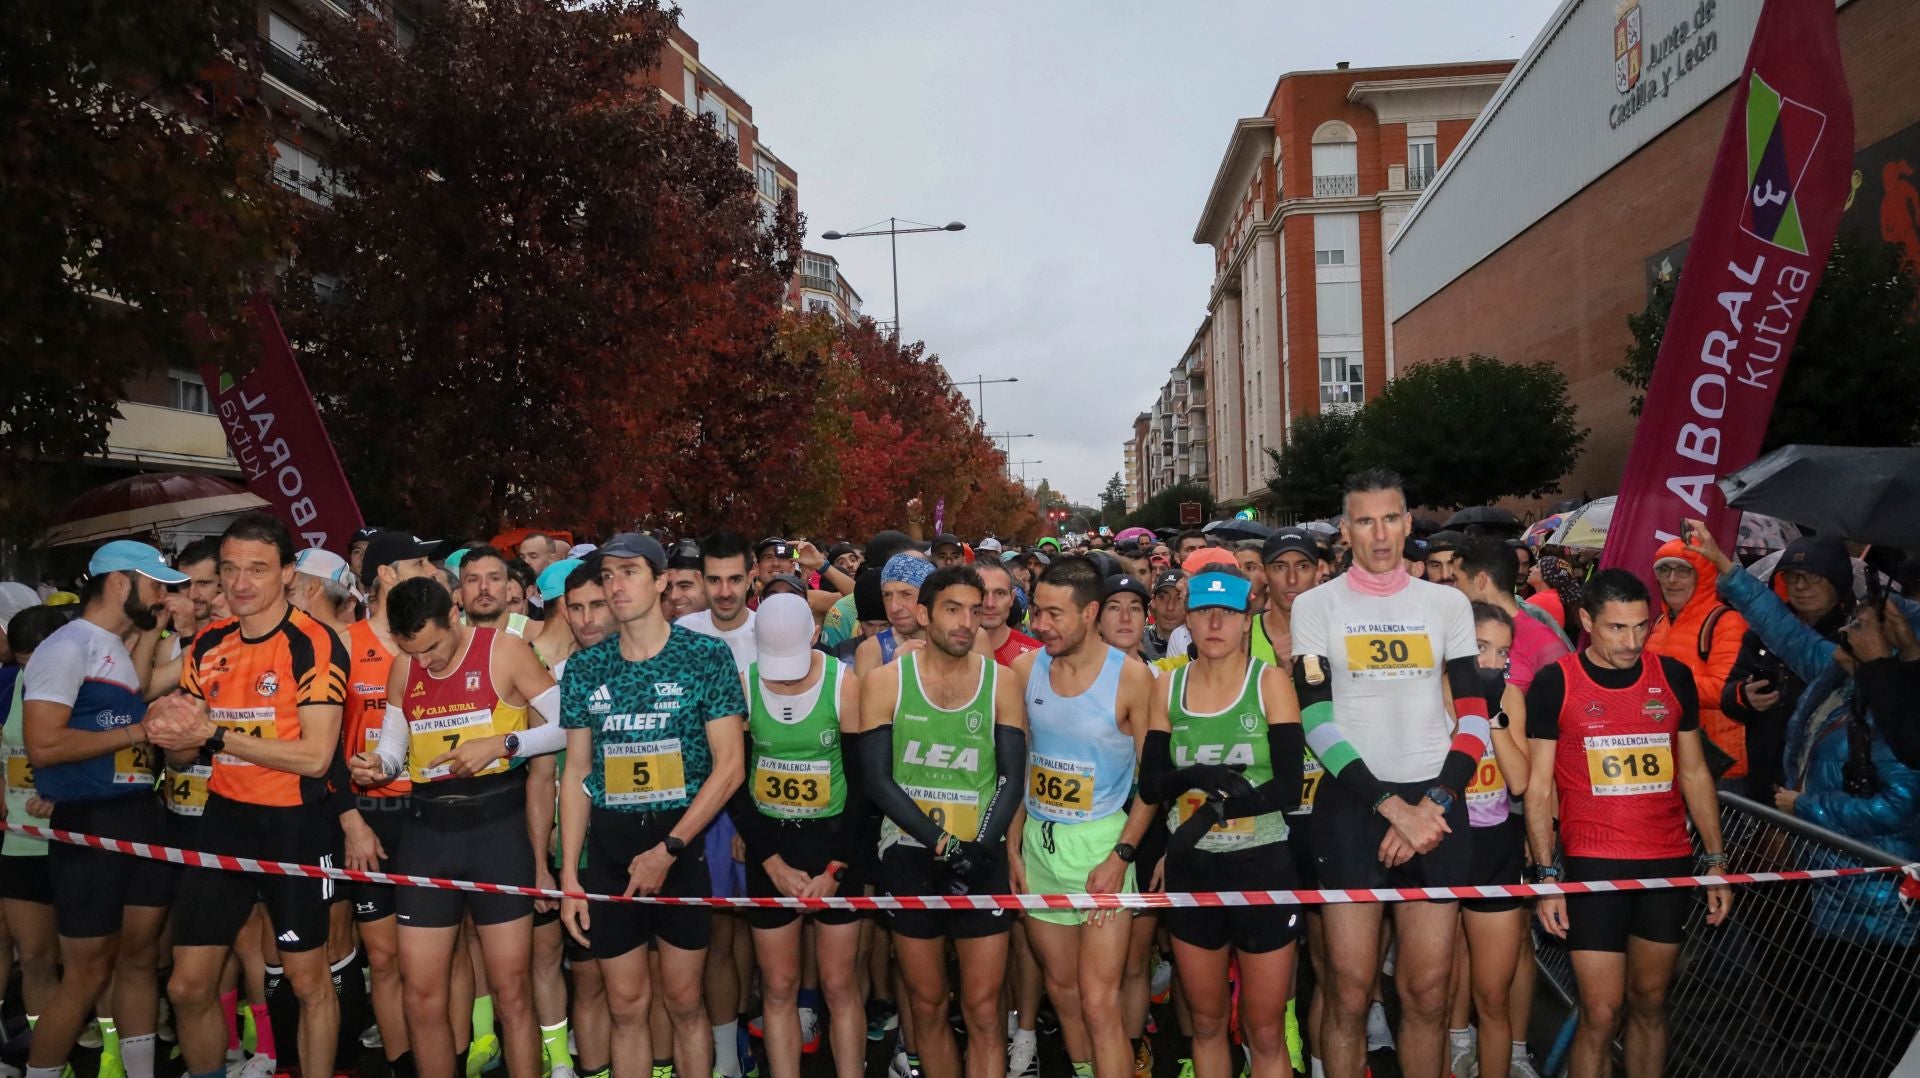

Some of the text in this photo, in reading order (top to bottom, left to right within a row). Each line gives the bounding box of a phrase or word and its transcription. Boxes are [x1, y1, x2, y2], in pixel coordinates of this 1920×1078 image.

[1646, 0, 1717, 72] Junta de
[1608, 79, 1658, 130] Castilla
[1661, 66, 1672, 98] y
[1590, 526, 1608, 536] aren
[1369, 624, 1406, 633] PALENCIA
[1369, 639, 1409, 663] 30
[226, 711, 256, 720] PALENCIA
[426, 703, 477, 716] CAJA RURAL
[433, 716, 470, 729] PALENCIA
[601, 712, 671, 732] ATLEET
[442, 733, 460, 752] 7
[625, 743, 660, 754] PALENCIA
[1611, 736, 1649, 747] PALENCIA
[902, 740, 979, 772] LEA
[1175, 743, 1255, 767] LEA
[632, 762, 651, 786] 5
[777, 762, 811, 772] PALENCIA
[1045, 758, 1075, 772] PALENCIA
[1602, 753, 1660, 778] 618
[766, 776, 818, 801] 363
[923, 789, 959, 801] PALENCIA
[1035, 772, 1081, 804] 362
